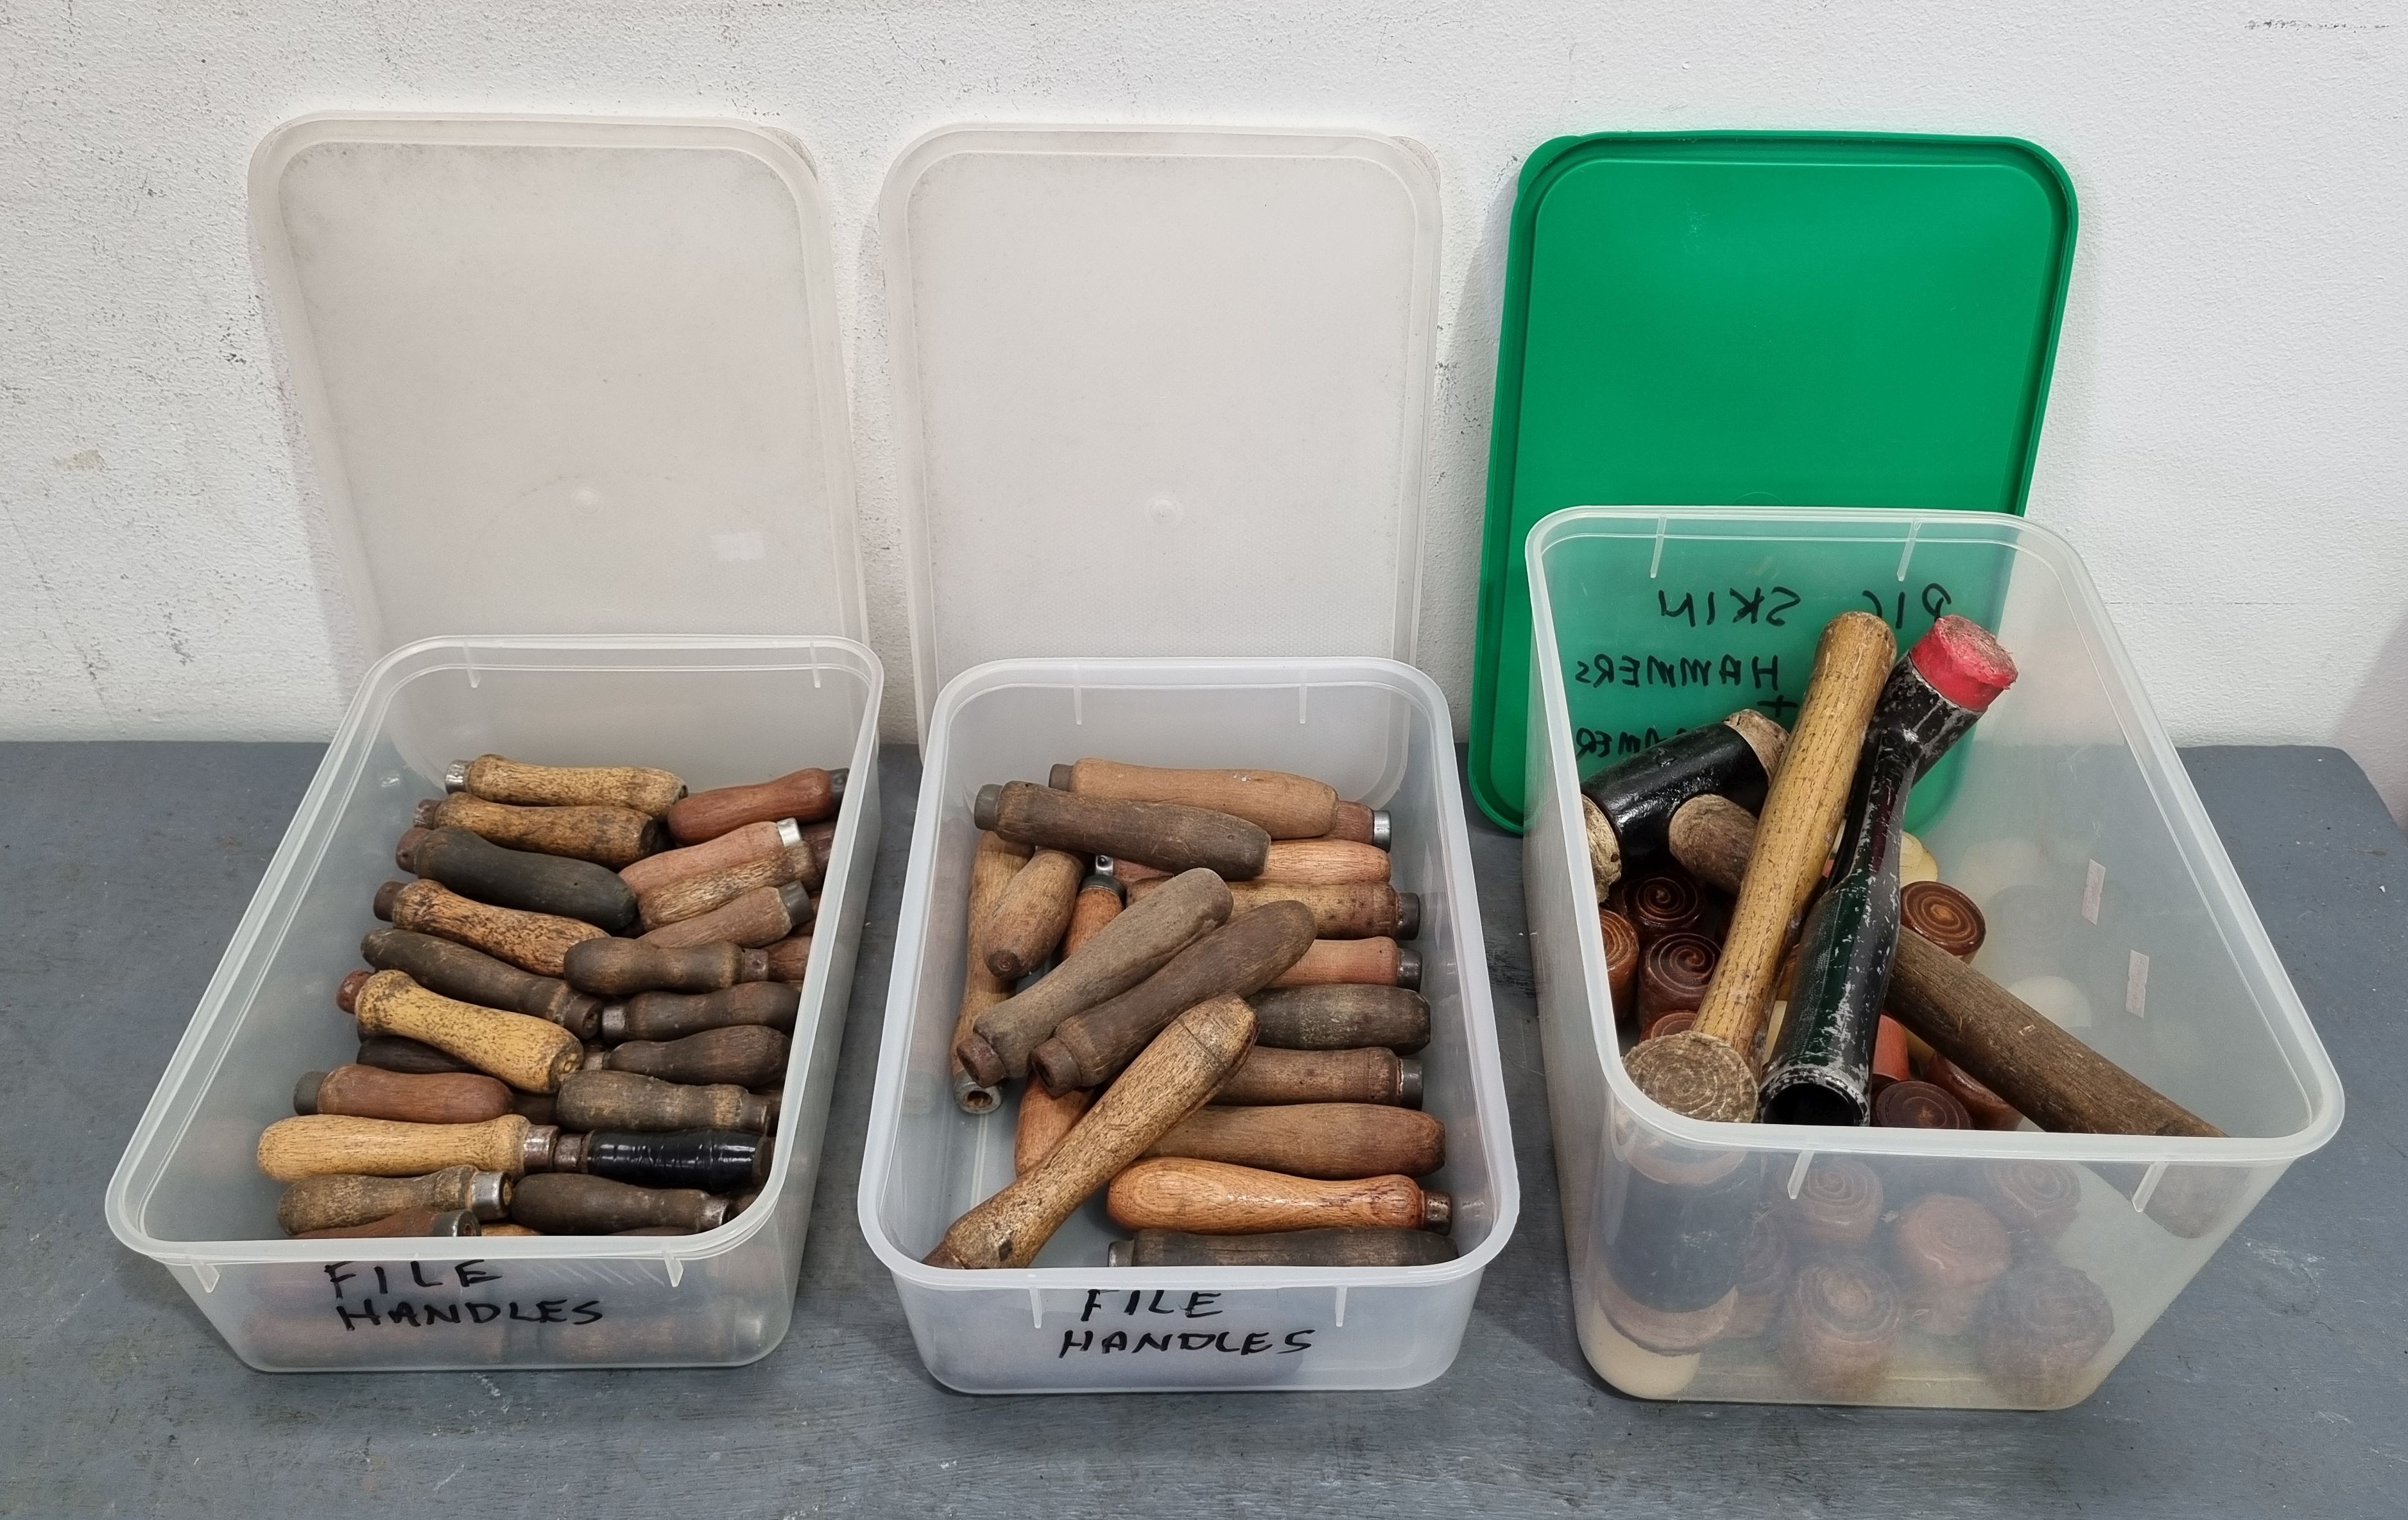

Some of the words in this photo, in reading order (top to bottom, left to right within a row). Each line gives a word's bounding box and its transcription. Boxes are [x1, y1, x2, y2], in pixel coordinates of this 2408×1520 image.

[323, 1259, 503, 1299] FILE
[337, 1298, 604, 1331] HANDLES
[1080, 1288, 1223, 1322] FILE
[1058, 1329, 1316, 1358] HANDLES
